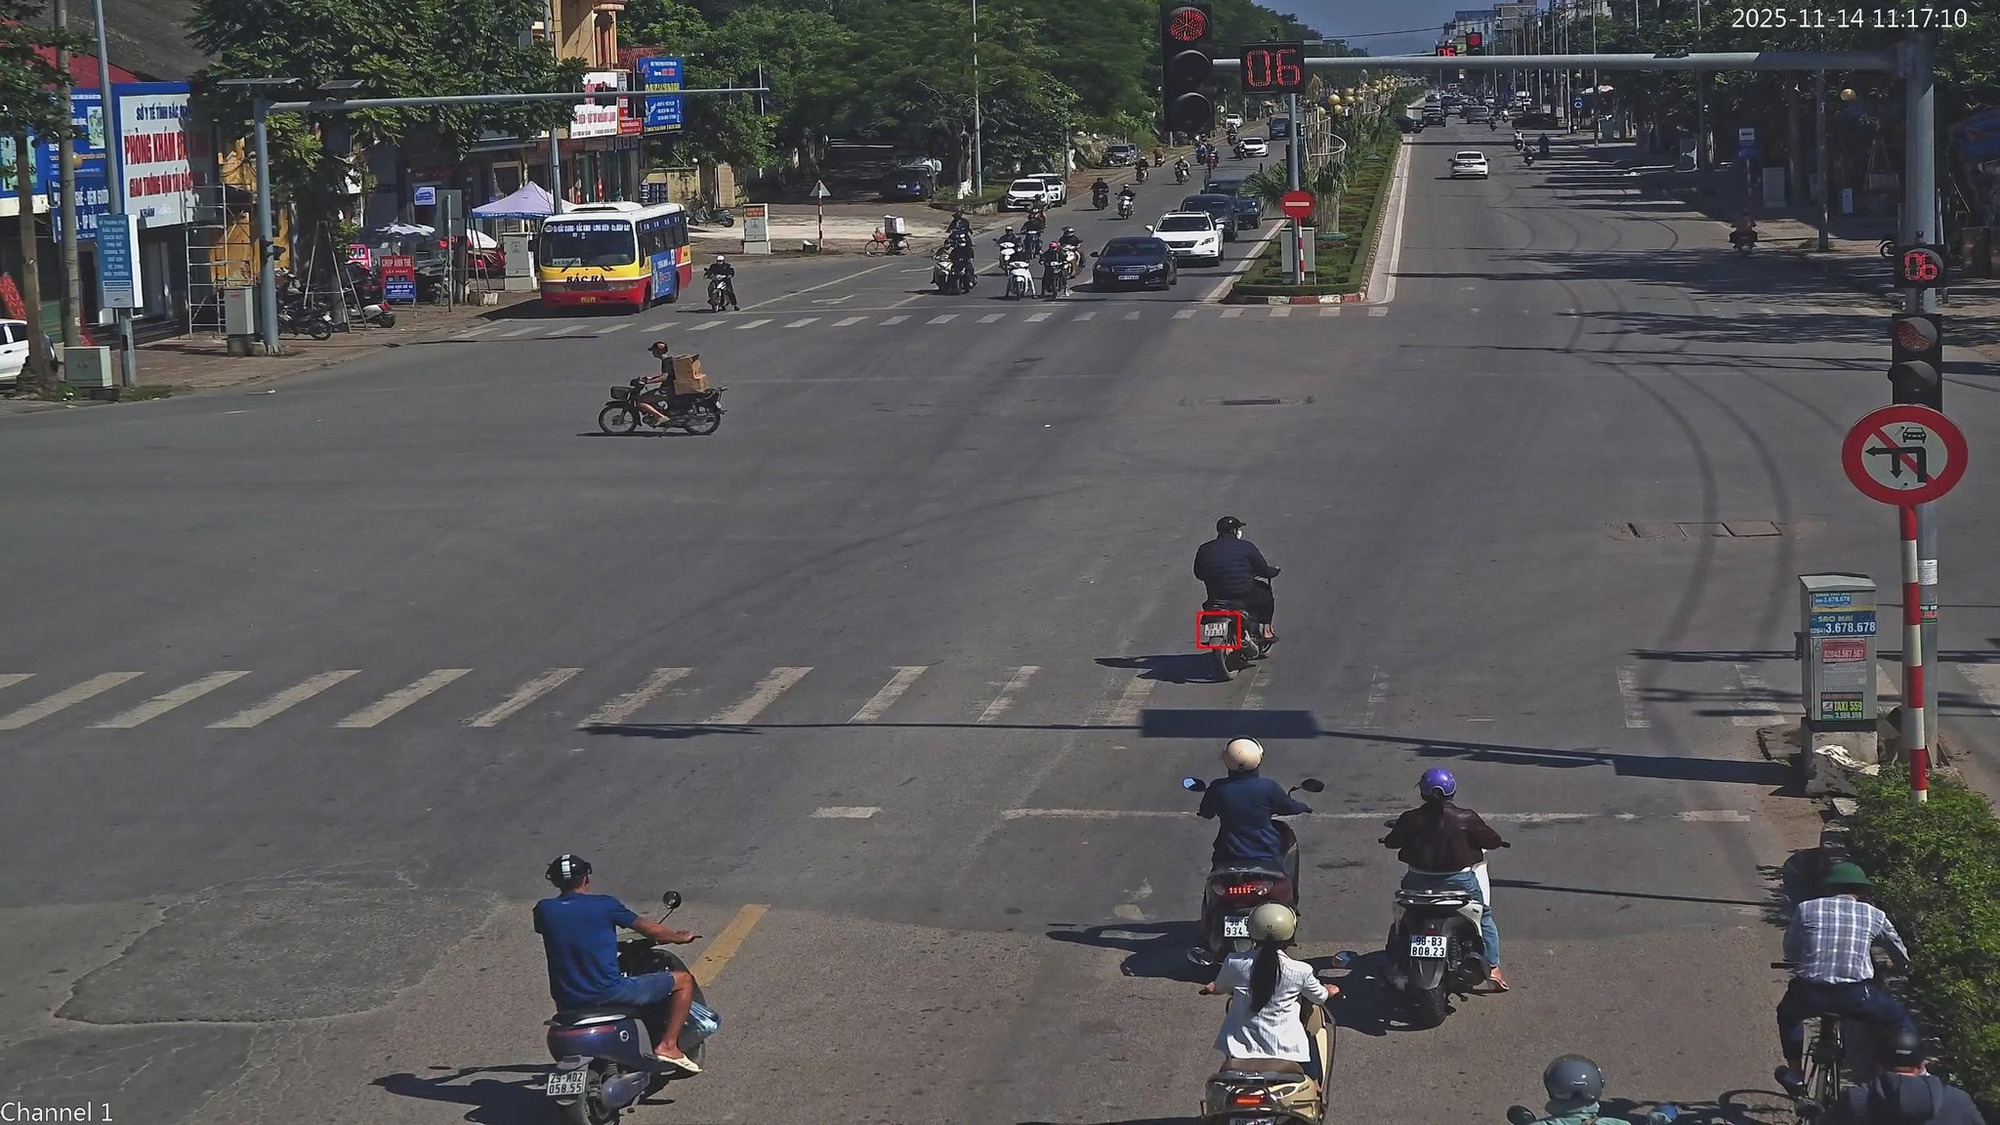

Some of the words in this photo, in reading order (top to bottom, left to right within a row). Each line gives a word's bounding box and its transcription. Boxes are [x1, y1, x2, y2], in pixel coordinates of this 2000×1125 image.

[1247, 49, 1300, 87] 06
[124, 127, 152, 165] PHÒNG
[153, 126, 175, 162] KHÁM
[1904, 252, 1938, 280] 06
[1825, 621, 1876, 633] 3.678.678
[1834, 701, 1849, 711] TAXI
[1849, 701, 1863, 711] 559
[1416, 937, 1442, 946] 98-B3
[1413, 947, 1444, 956] 808.23
[549, 1083, 582, 1094] 058.55
